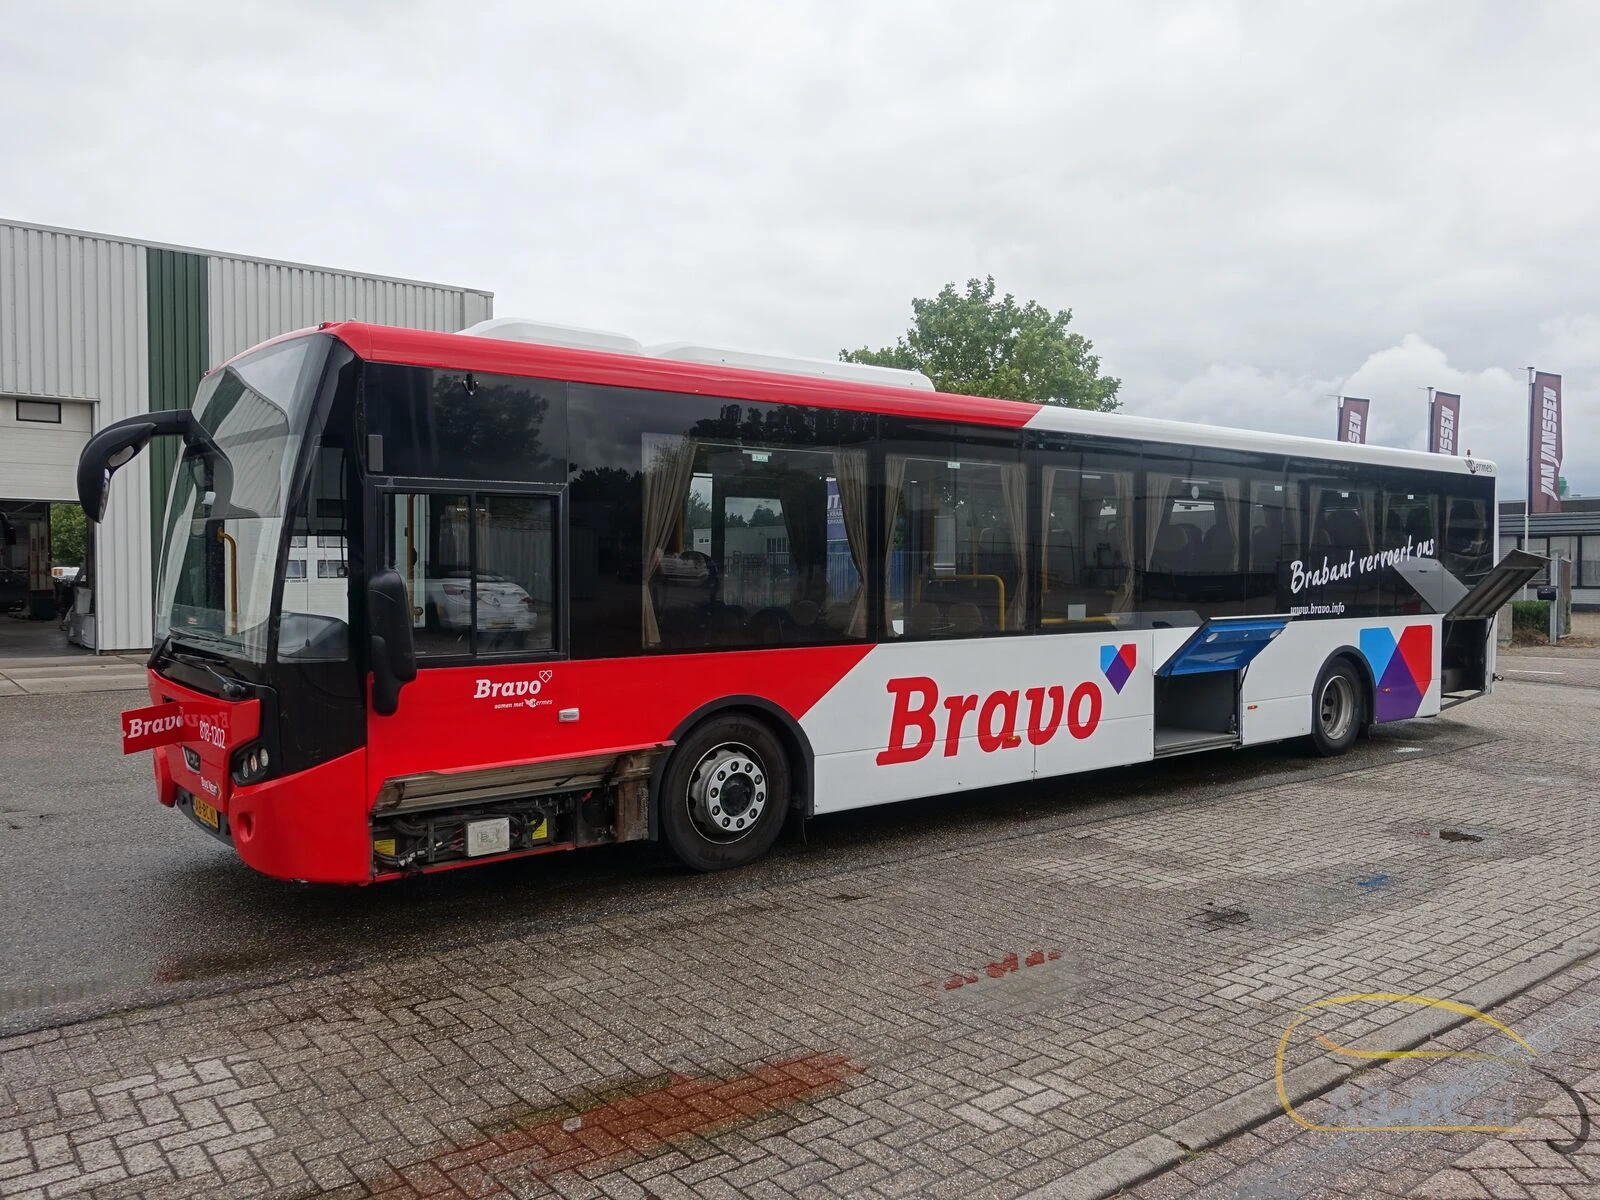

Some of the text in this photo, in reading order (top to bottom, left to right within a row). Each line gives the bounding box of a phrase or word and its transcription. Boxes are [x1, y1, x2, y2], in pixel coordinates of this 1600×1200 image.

[1347, 410, 1362, 444] SEN
[1540, 386, 1560, 501] JAN JANSSEN
[1290, 535, 1435, 594] Brabant vervoert ons
[1290, 602, 1345, 616] www.bravo.info
[473, 679, 542, 699] Bravo
[127, 714, 183, 739] Bravo
[876, 676, 1103, 766] Bravo
